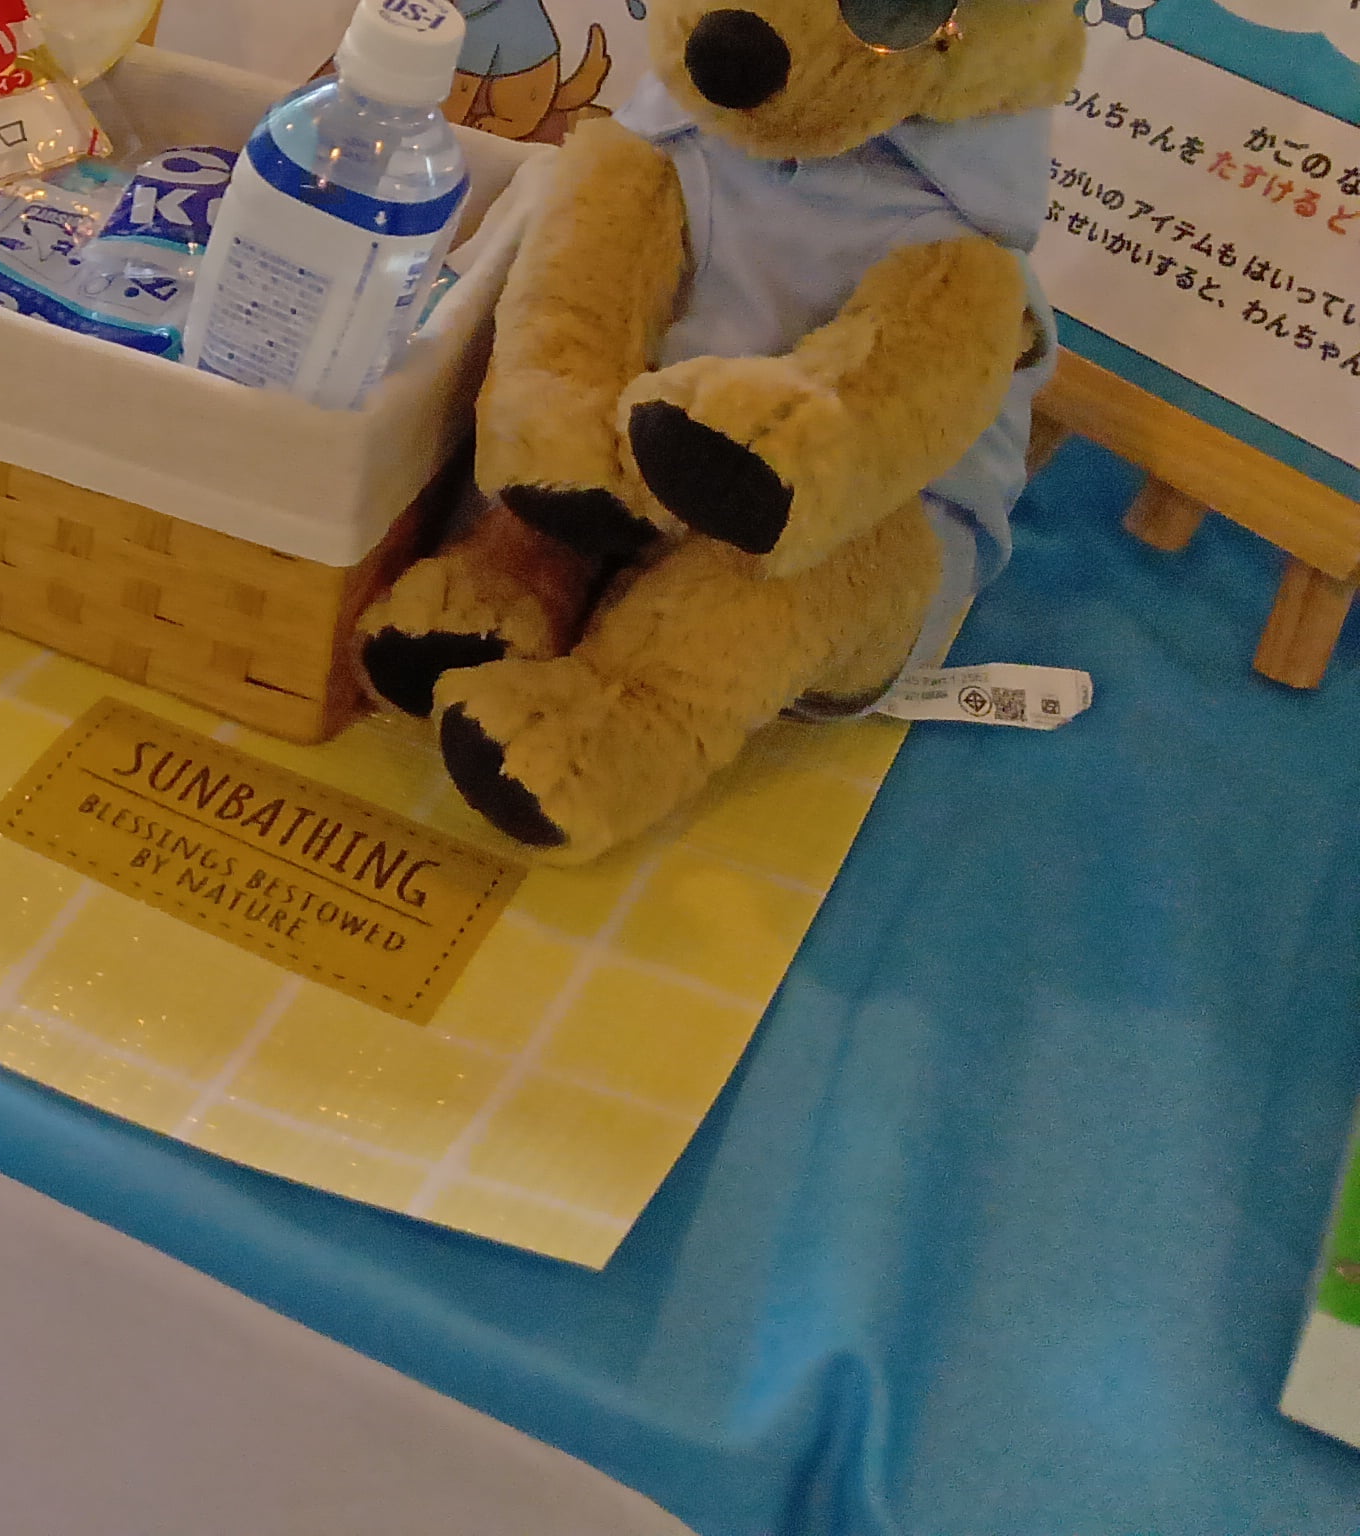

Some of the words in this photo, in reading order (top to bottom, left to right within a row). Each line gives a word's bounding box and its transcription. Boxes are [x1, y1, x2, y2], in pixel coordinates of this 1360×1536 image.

[77, 793, 239, 877] BLESSINGS
[244, 868, 407, 953] BESTOWED
[112, 740, 441, 908] SUNBATHING
[129, 846, 171, 875] BY
[175, 867, 307, 945] NATURE
